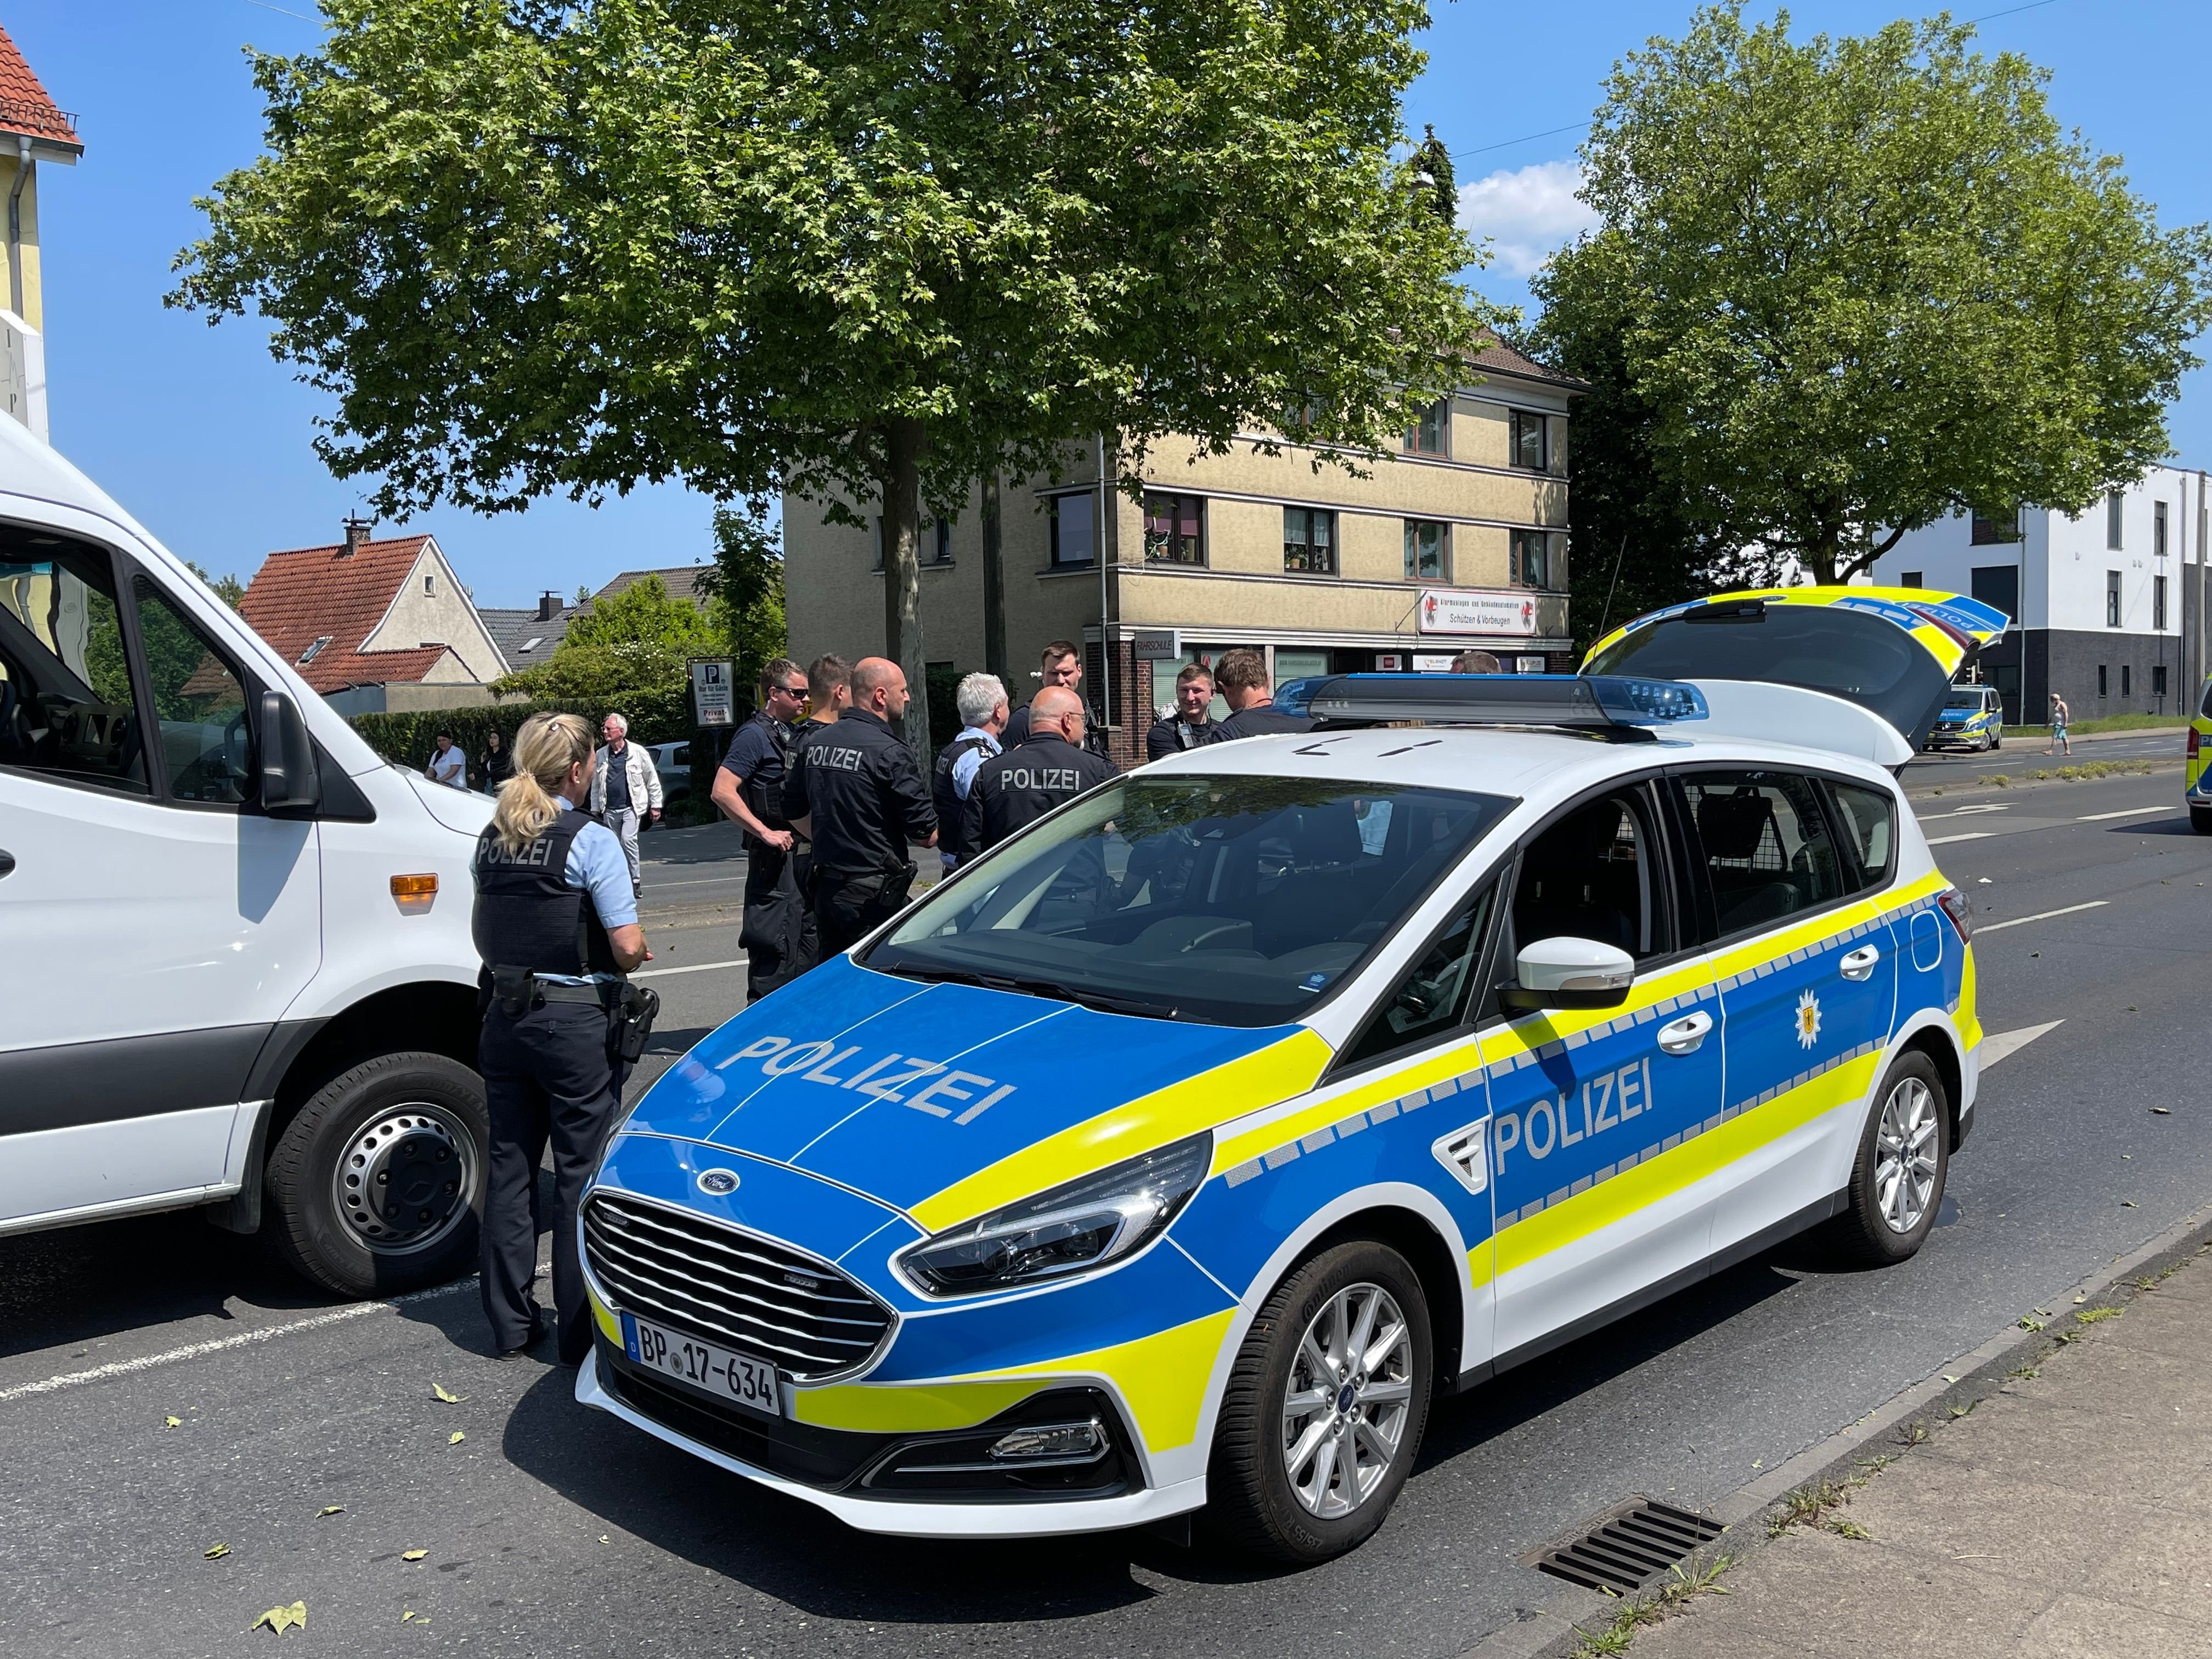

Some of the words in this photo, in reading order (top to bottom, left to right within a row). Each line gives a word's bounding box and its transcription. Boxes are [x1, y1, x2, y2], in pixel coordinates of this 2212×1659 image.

[1440, 599, 1469, 607] Alarmanlagen
[1449, 613, 1476, 624] Schützen
[1477, 614, 1481, 624] &
[1482, 614, 1510, 627] Vorbeugen
[1136, 640, 1172, 651] FAHRSCHULE
[2200, 736, 2212, 746] P
[805, 745, 863, 772] POLIZEI
[1001, 768, 1080, 791] POLIZEI
[714, 1036, 1018, 1126] POLIZEI
[1494, 1057, 1652, 1176] POLIZEI
[707, 1175, 731, 1189] Ford
[630, 1341, 637, 1353] D
[640, 1324, 667, 1367] BP
[683, 1342, 772, 1407] 17-634
